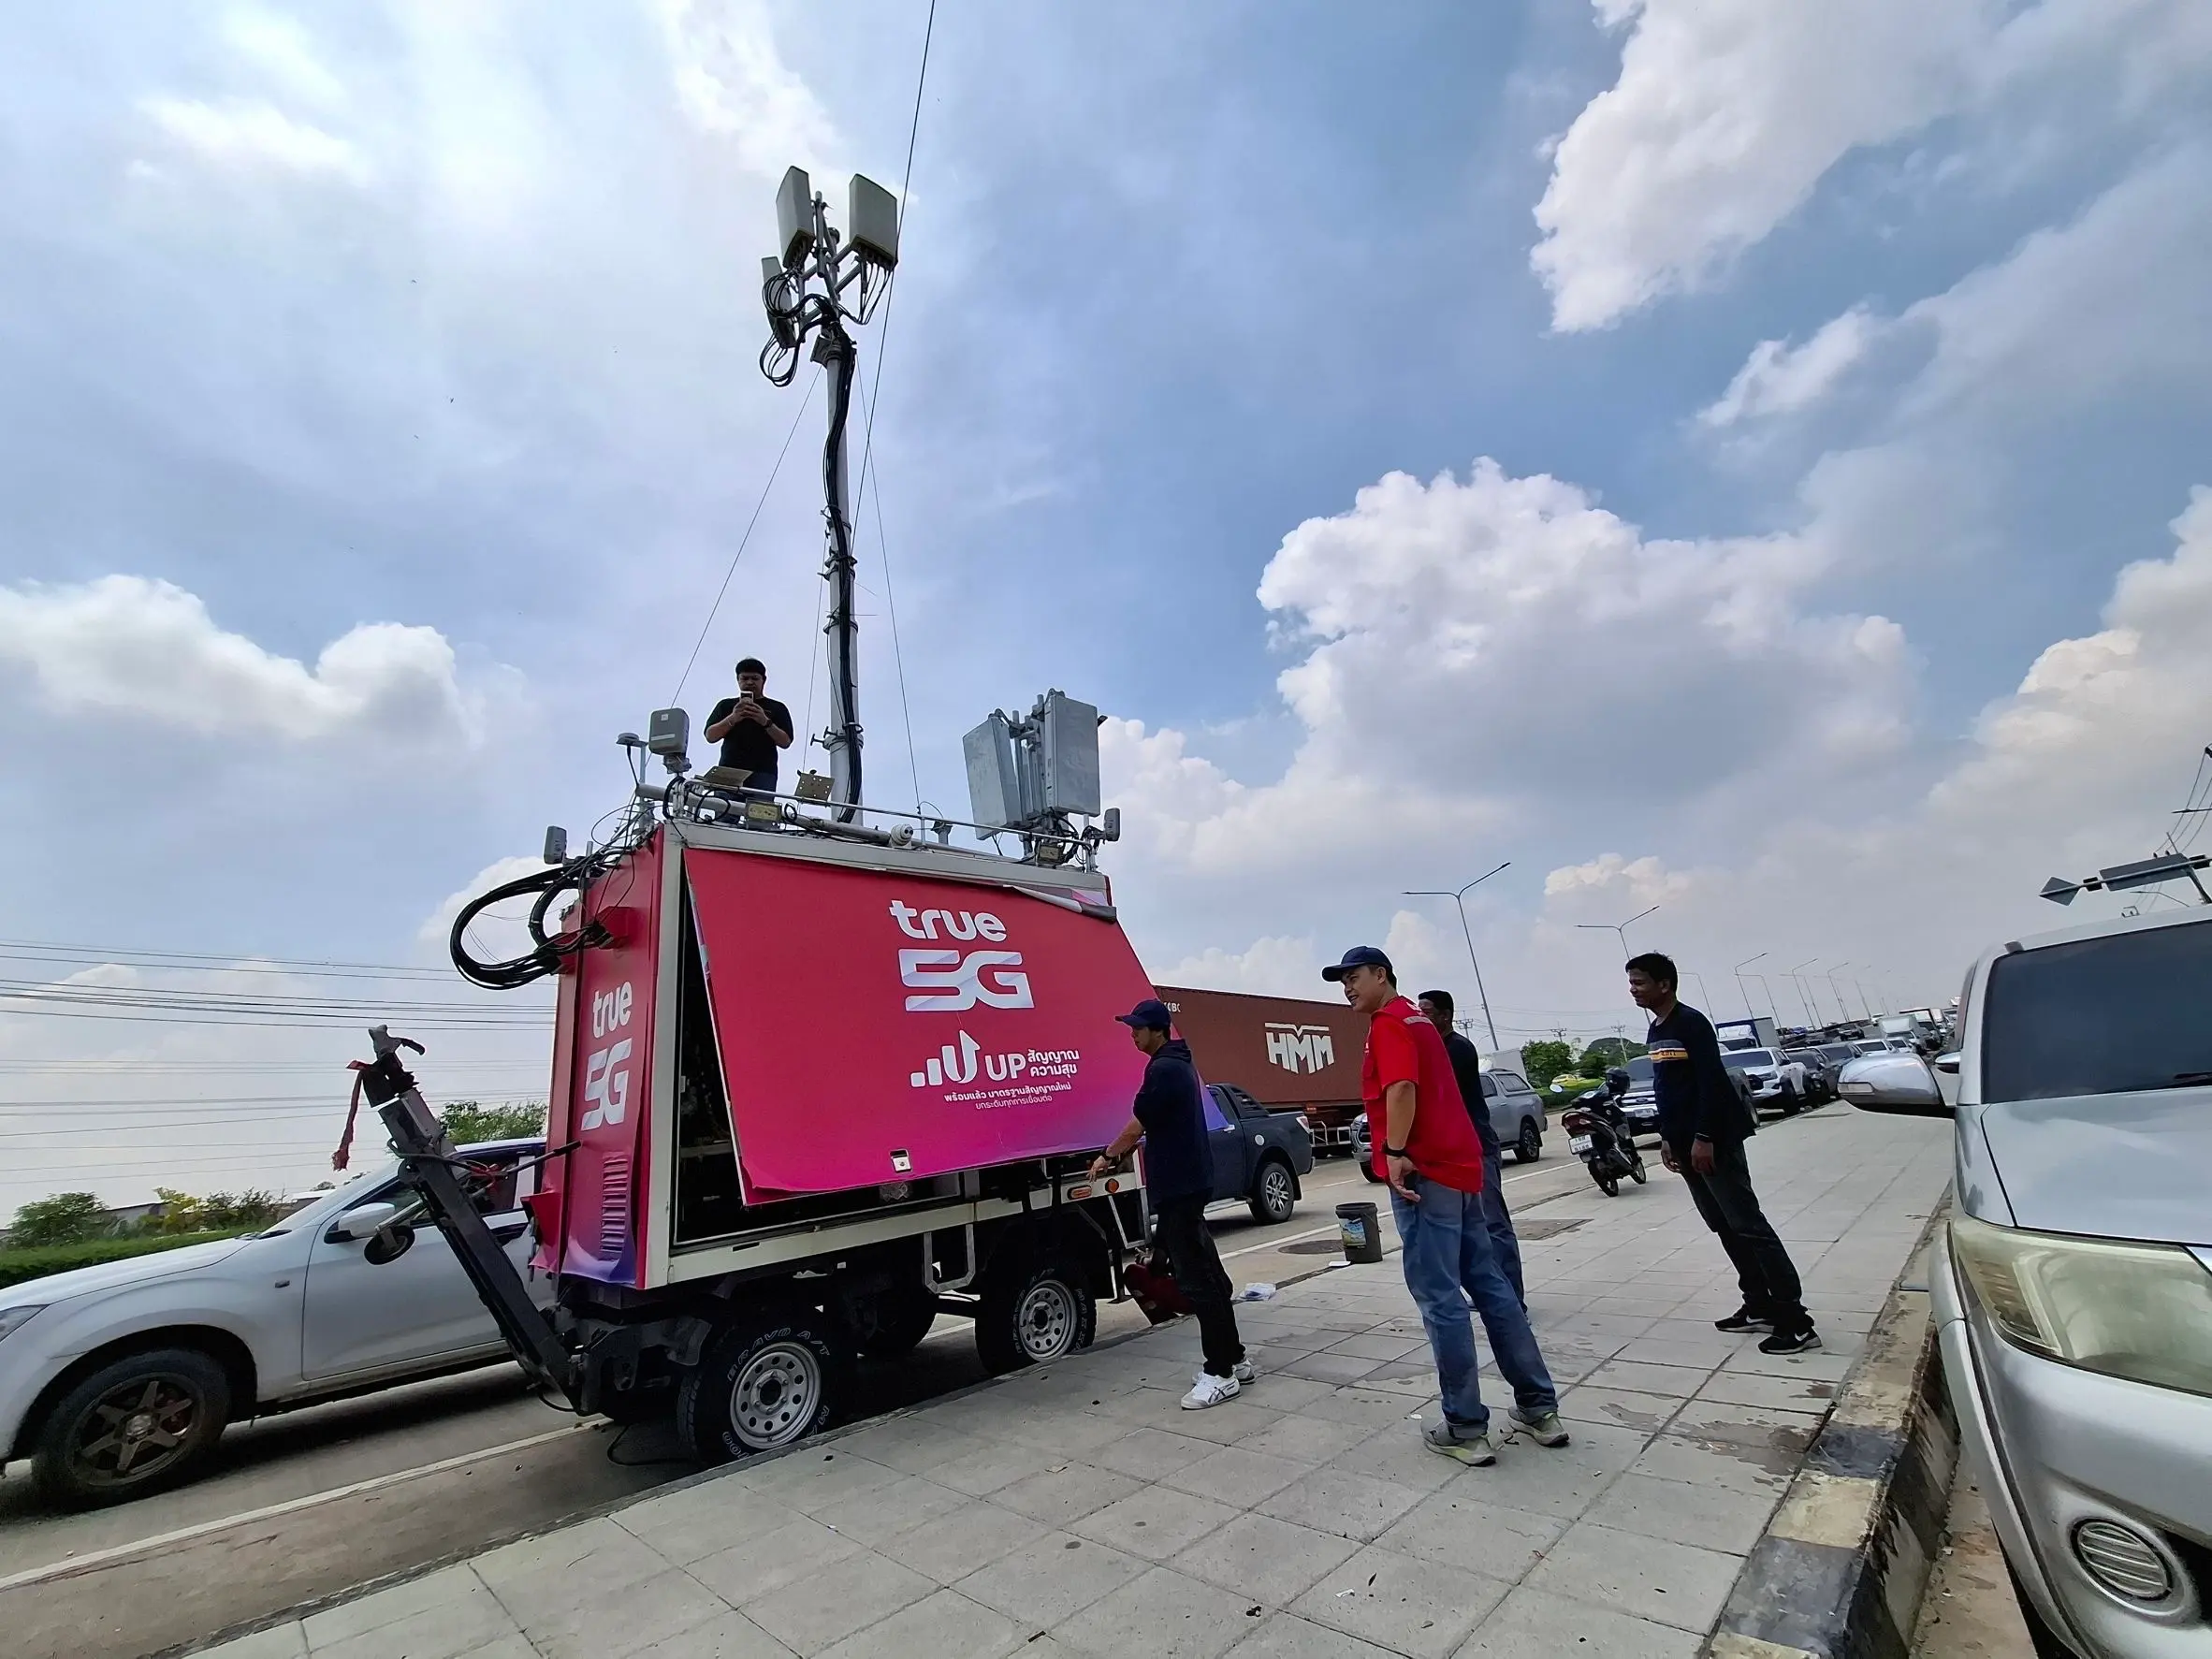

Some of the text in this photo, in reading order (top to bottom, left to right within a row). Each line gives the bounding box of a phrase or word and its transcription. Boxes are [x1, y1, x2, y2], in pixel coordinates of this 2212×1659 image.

[890, 900, 1007, 941] true
[898, 949, 1035, 1011] 5G
[592, 981, 633, 1038] true
[984, 1054, 1026, 1081] UP
[1027, 1049, 1080, 1065] สัญญาณ
[1030, 1063, 1077, 1079] ความสุข
[1265, 1031, 1335, 1074] HMM
[581, 1039, 633, 1131] 5G
[944, 1090, 987, 1102] พร้อมแล้ว
